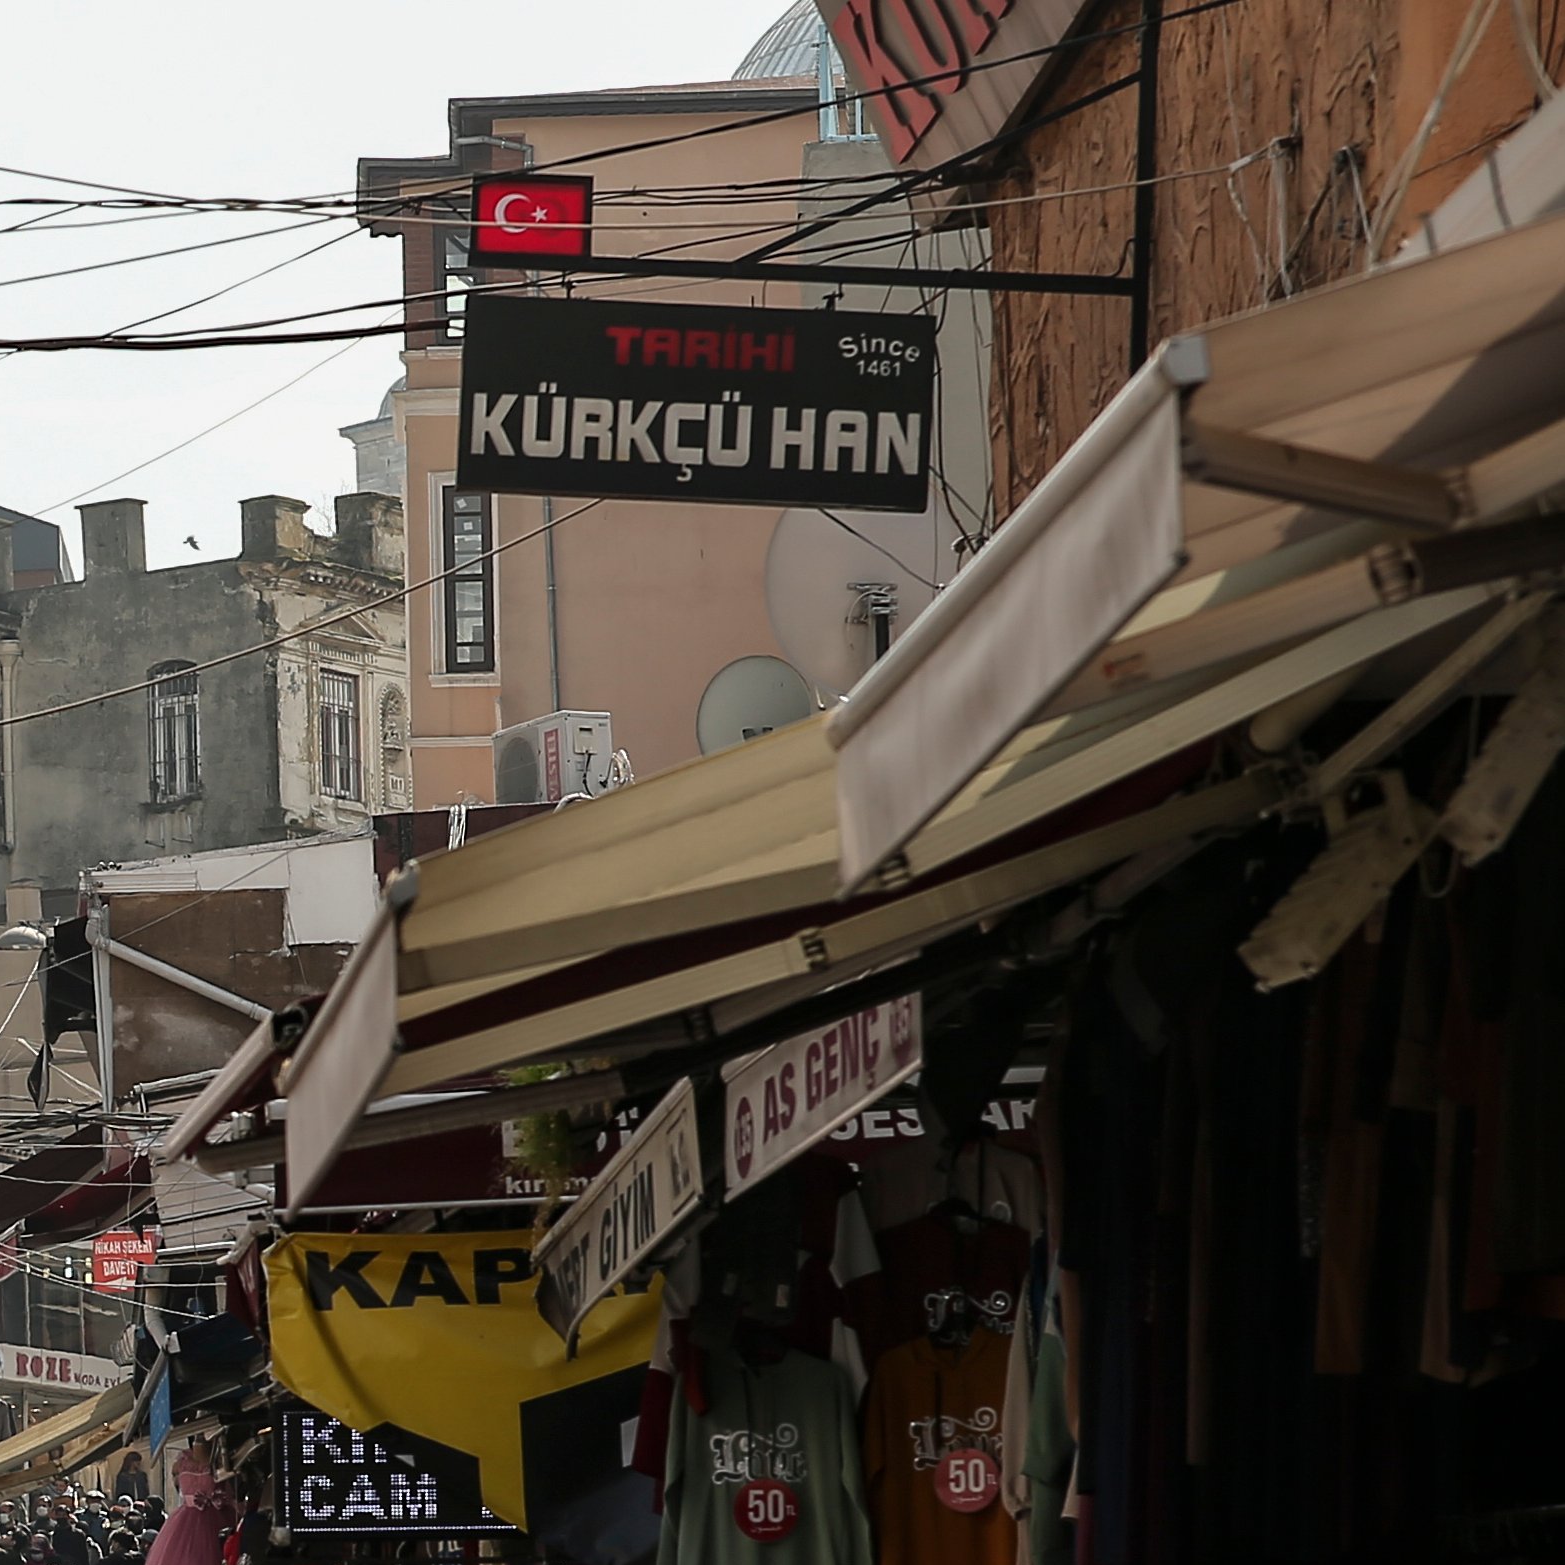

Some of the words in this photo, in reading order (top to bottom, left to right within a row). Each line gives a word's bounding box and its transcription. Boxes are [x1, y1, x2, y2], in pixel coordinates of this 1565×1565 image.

[606, 323, 794, 372] TARİHİ
[838, 333, 920, 362] Since
[856, 360, 901, 377] 1461
[470, 381, 752, 482] KÜRKÇÜ
[769, 406, 921, 475] HAN
[763, 1061, 796, 1144] AS
[599, 1162, 656, 1281] GİYİM
[16, 1352, 71, 1383] ROZE
[299, 1473, 438, 1520] CAM
[949, 1458, 986, 1494] 50
[747, 1488, 784, 1524] 50
